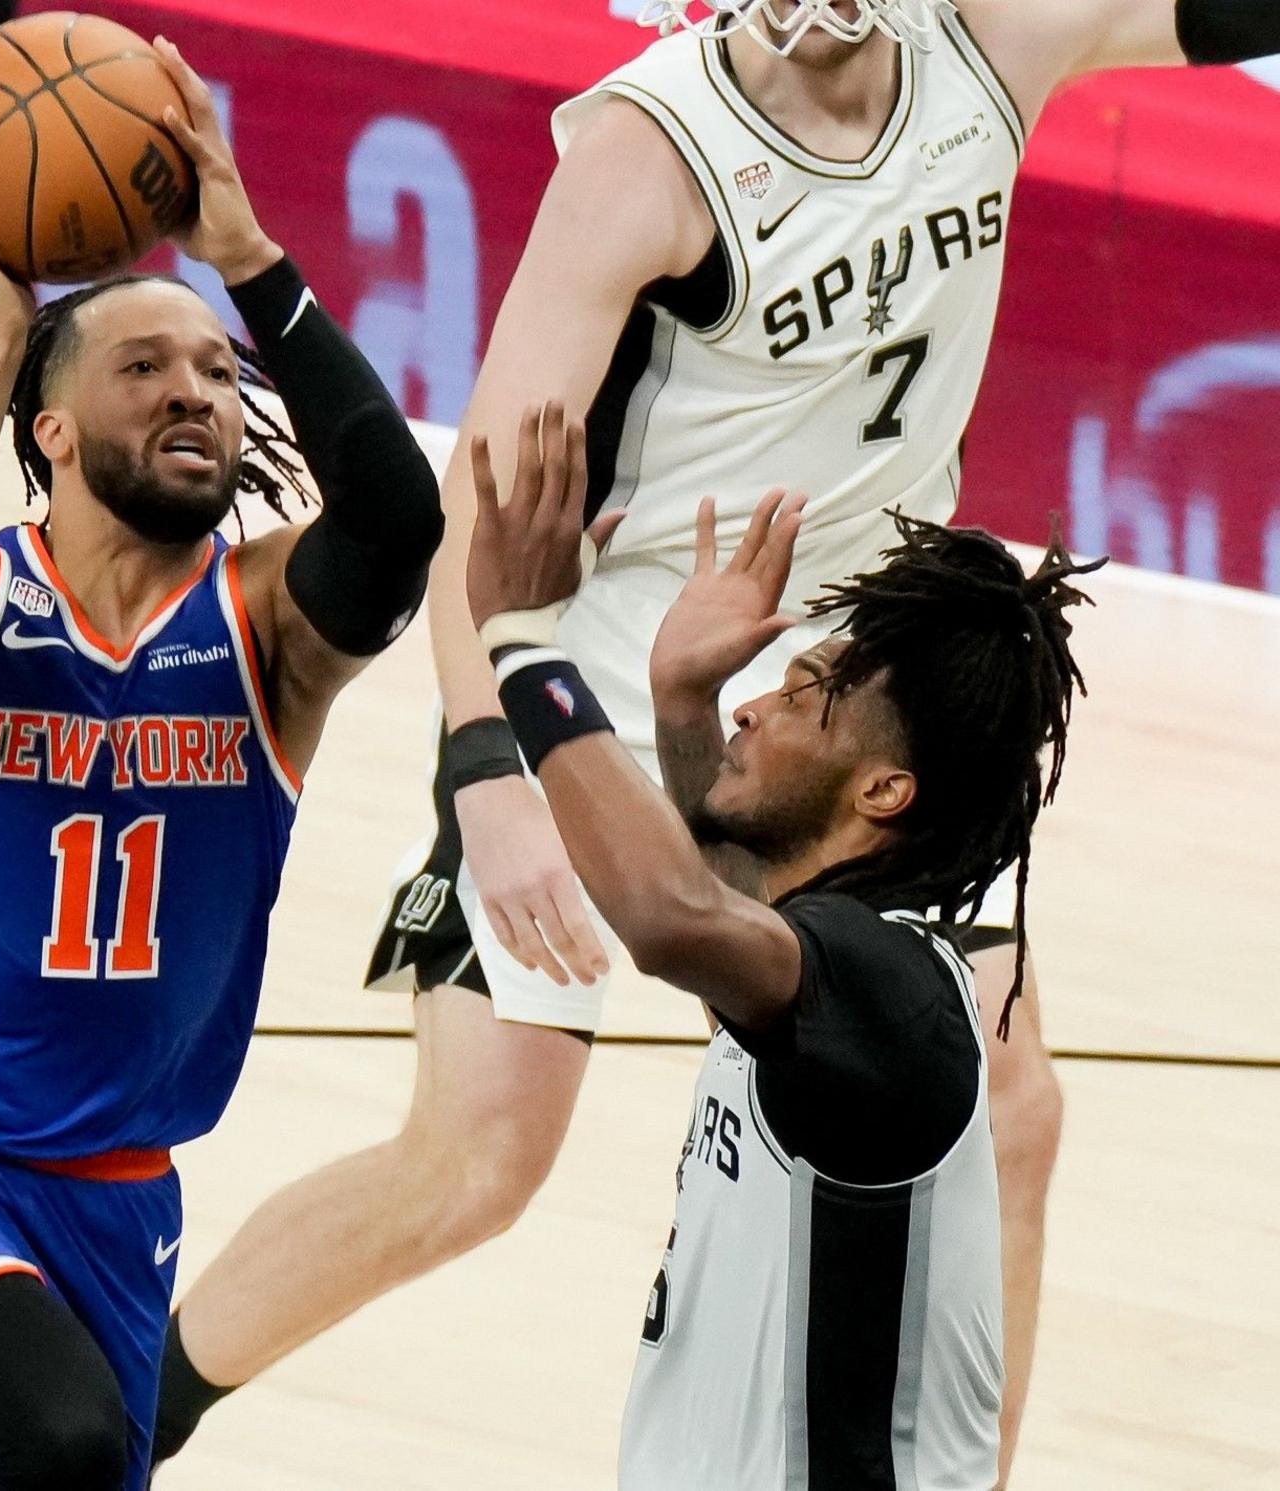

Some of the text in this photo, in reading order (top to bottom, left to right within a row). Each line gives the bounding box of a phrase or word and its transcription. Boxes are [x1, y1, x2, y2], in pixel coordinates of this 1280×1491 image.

[929, 125, 979, 160] LEDGER
[763, 192, 1003, 360] SPURS
[859, 329, 933, 446] 7
[148, 653, 180, 671] abu
[182, 642, 229, 665] dhabi
[108, 715, 250, 789] YORK
[41, 813, 166, 979] 11
